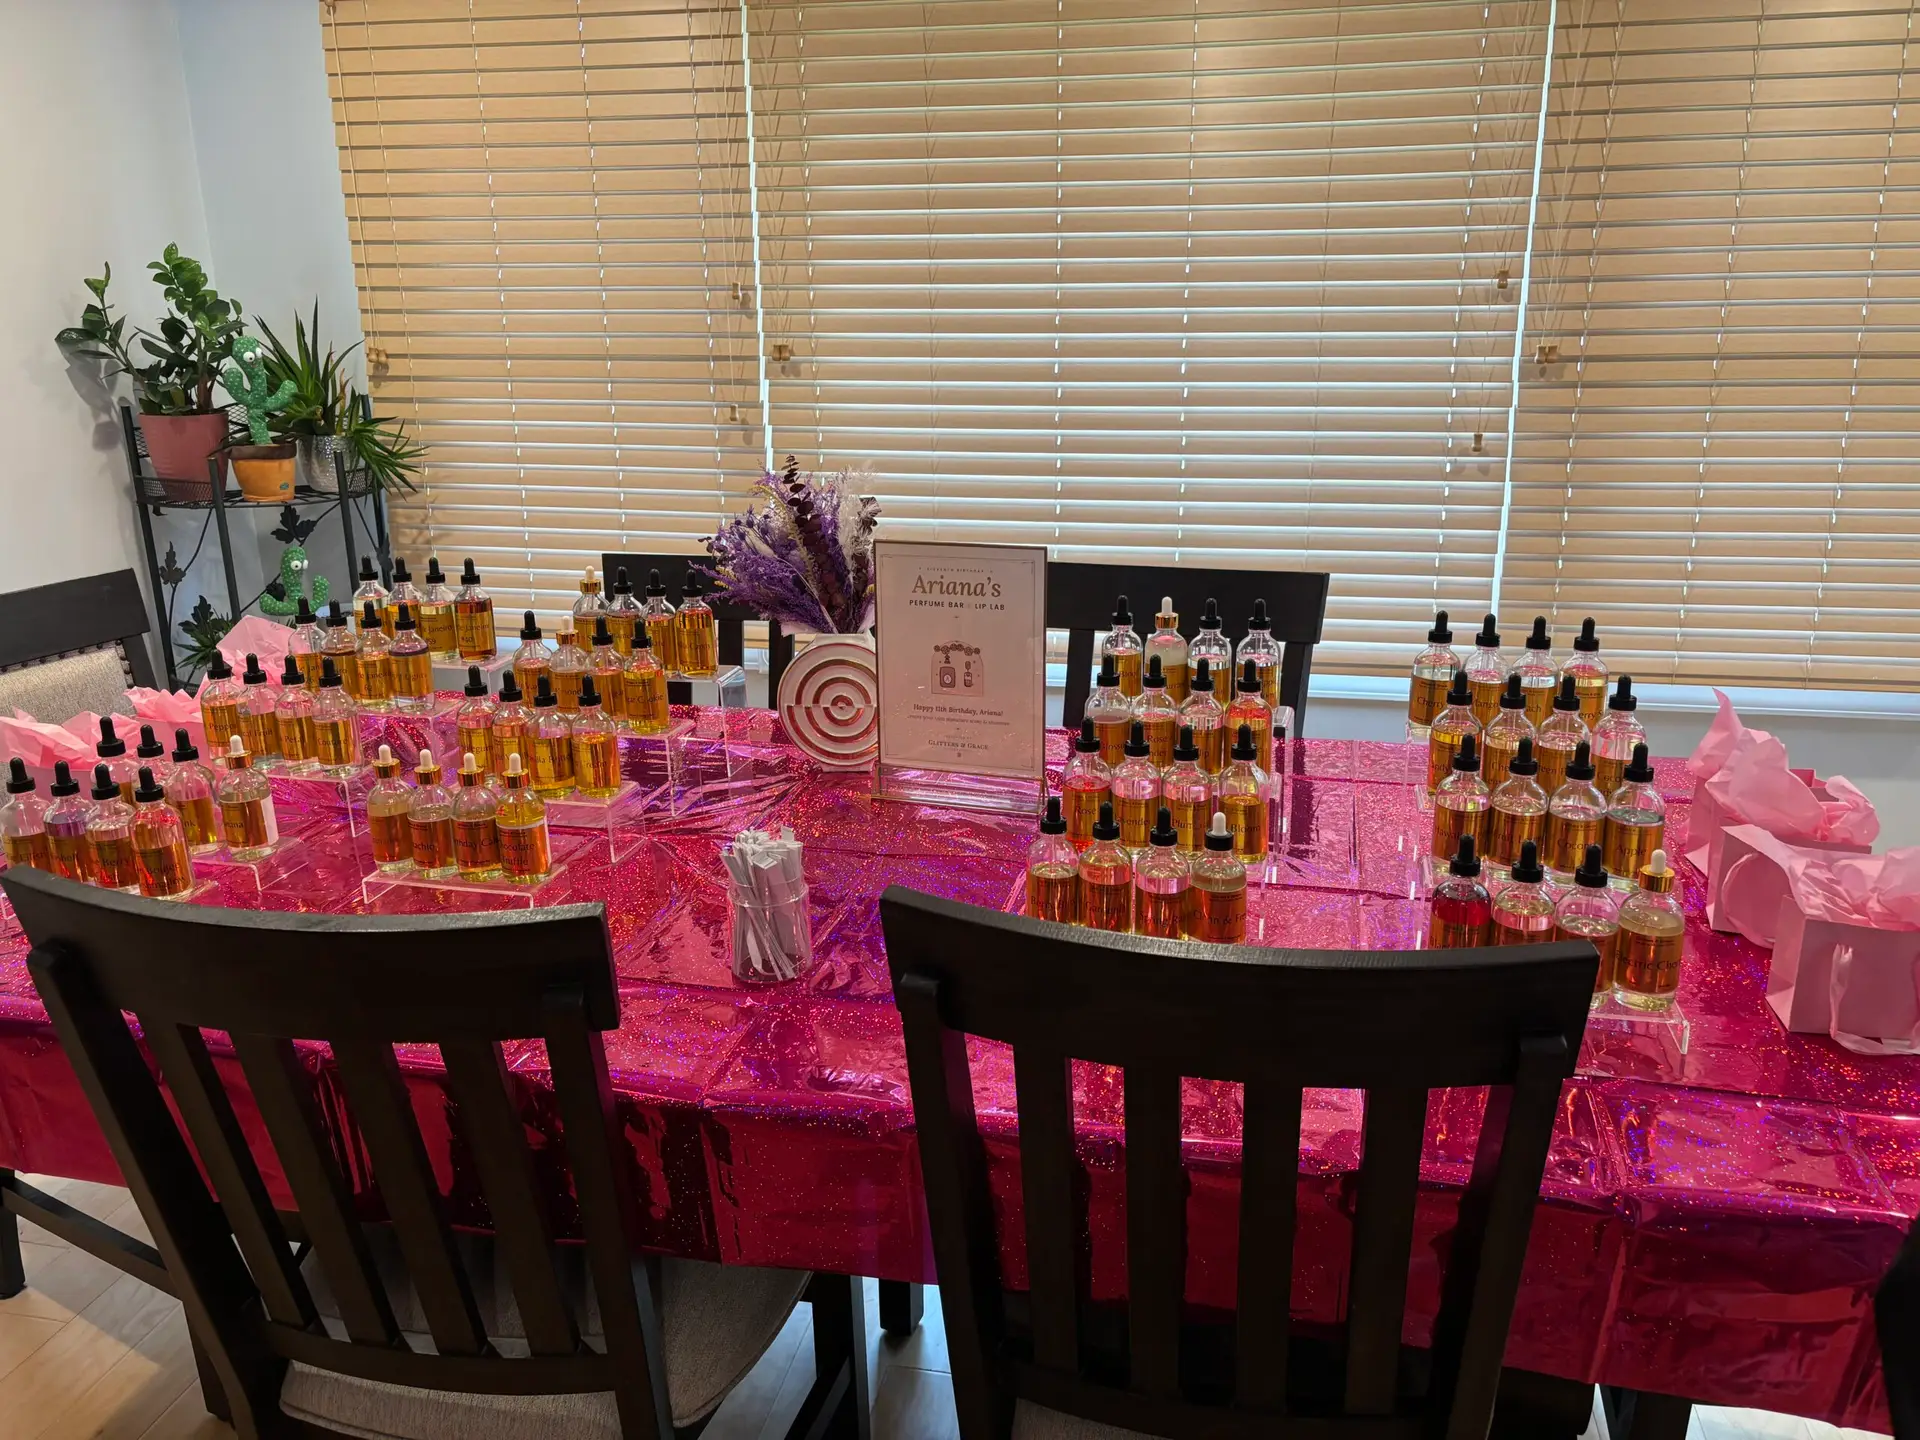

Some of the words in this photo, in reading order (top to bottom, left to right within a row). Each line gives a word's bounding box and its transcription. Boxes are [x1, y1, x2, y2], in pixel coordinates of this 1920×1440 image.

[911, 574, 1002, 598] Ariana's
[909, 600, 945, 608] PERFUME
[1416, 696, 1446, 710] Cherry
[913, 703, 934, 712] Happy
[949, 706, 979, 717] Birthday,
[1148, 735, 1168, 744] Rose
[1075, 806, 1097, 816] Rose
[1230, 823, 1261, 833] Bloom
[1223, 915, 1232, 925] &
